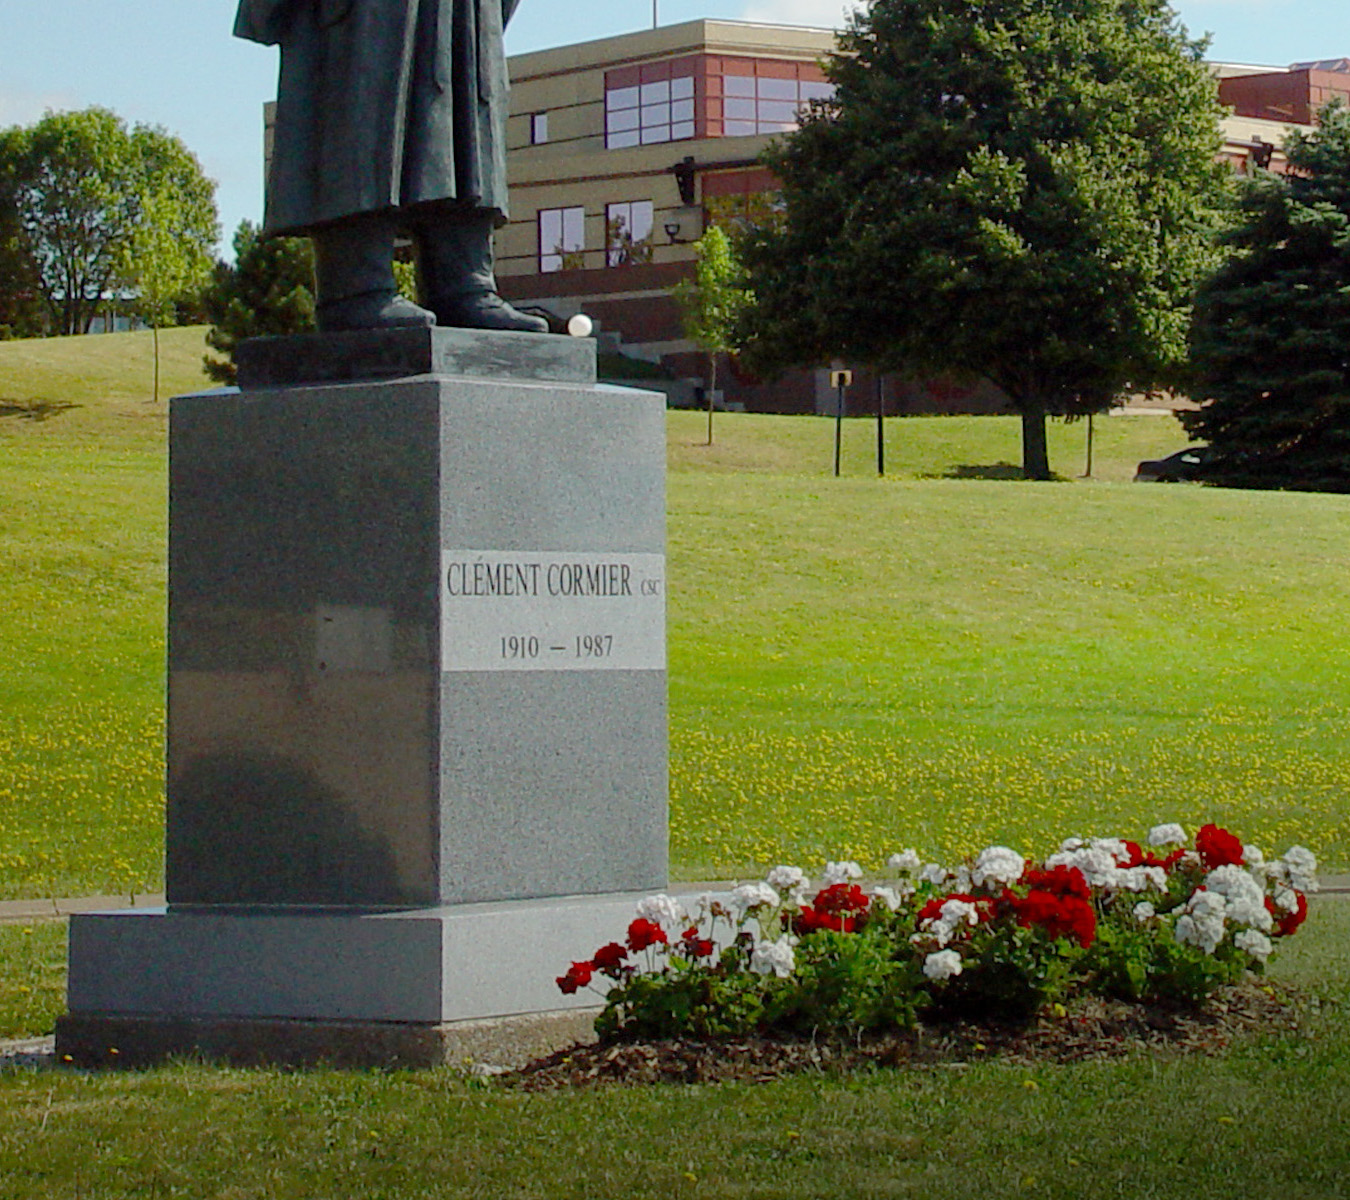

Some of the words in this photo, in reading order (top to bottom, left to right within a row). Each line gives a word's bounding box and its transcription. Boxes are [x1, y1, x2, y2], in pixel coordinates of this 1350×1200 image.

[447, 556, 541, 597] CLÉMENT
[547, 563, 632, 597] CORMIER
[501, 636, 540, 659] 1910
[575, 635, 614, 658] 1987
